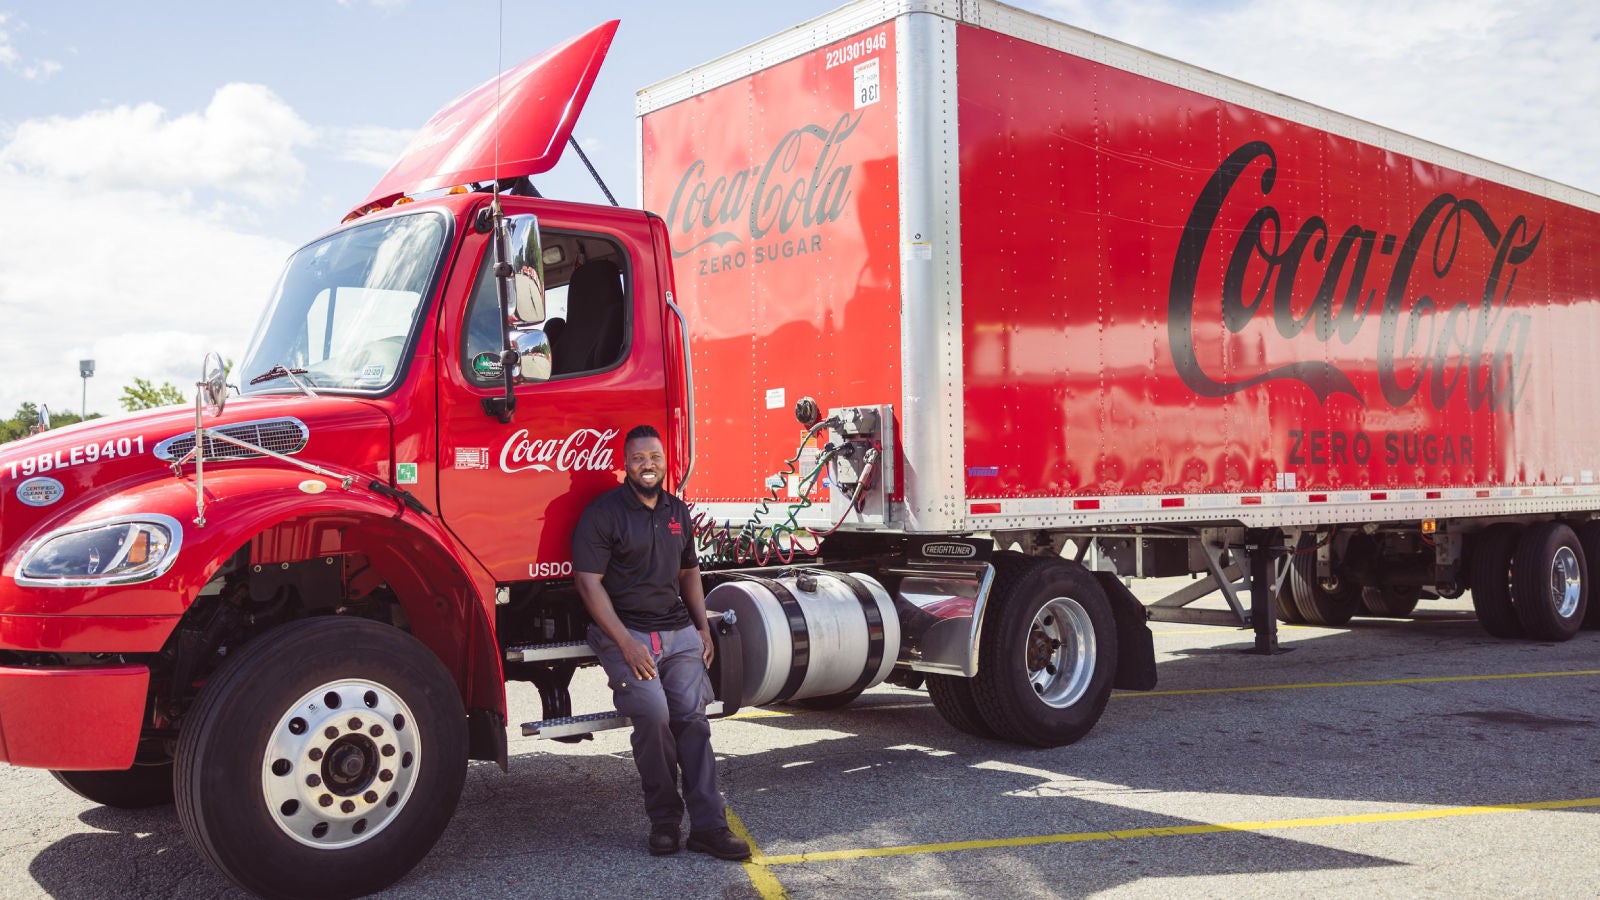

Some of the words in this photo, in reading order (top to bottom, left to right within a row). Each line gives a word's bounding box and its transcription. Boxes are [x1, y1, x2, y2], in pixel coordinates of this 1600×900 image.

[826, 32, 886, 70] 22U301946
[666, 110, 865, 259] Coca-Cola
[699, 251, 746, 276] ZERO
[755, 234, 822, 264] SUGAR
[1167, 140, 1545, 414] Coca-Cola
[6, 435, 145, 480] T9BLE9401
[499, 428, 620, 474] Coca-Cola
[1288, 429, 1371, 466] ZERO
[1385, 432, 1475, 466] SUGAR
[528, 561, 574, 578] USDO
[926, 545, 971, 554] FREIGHTLINER
